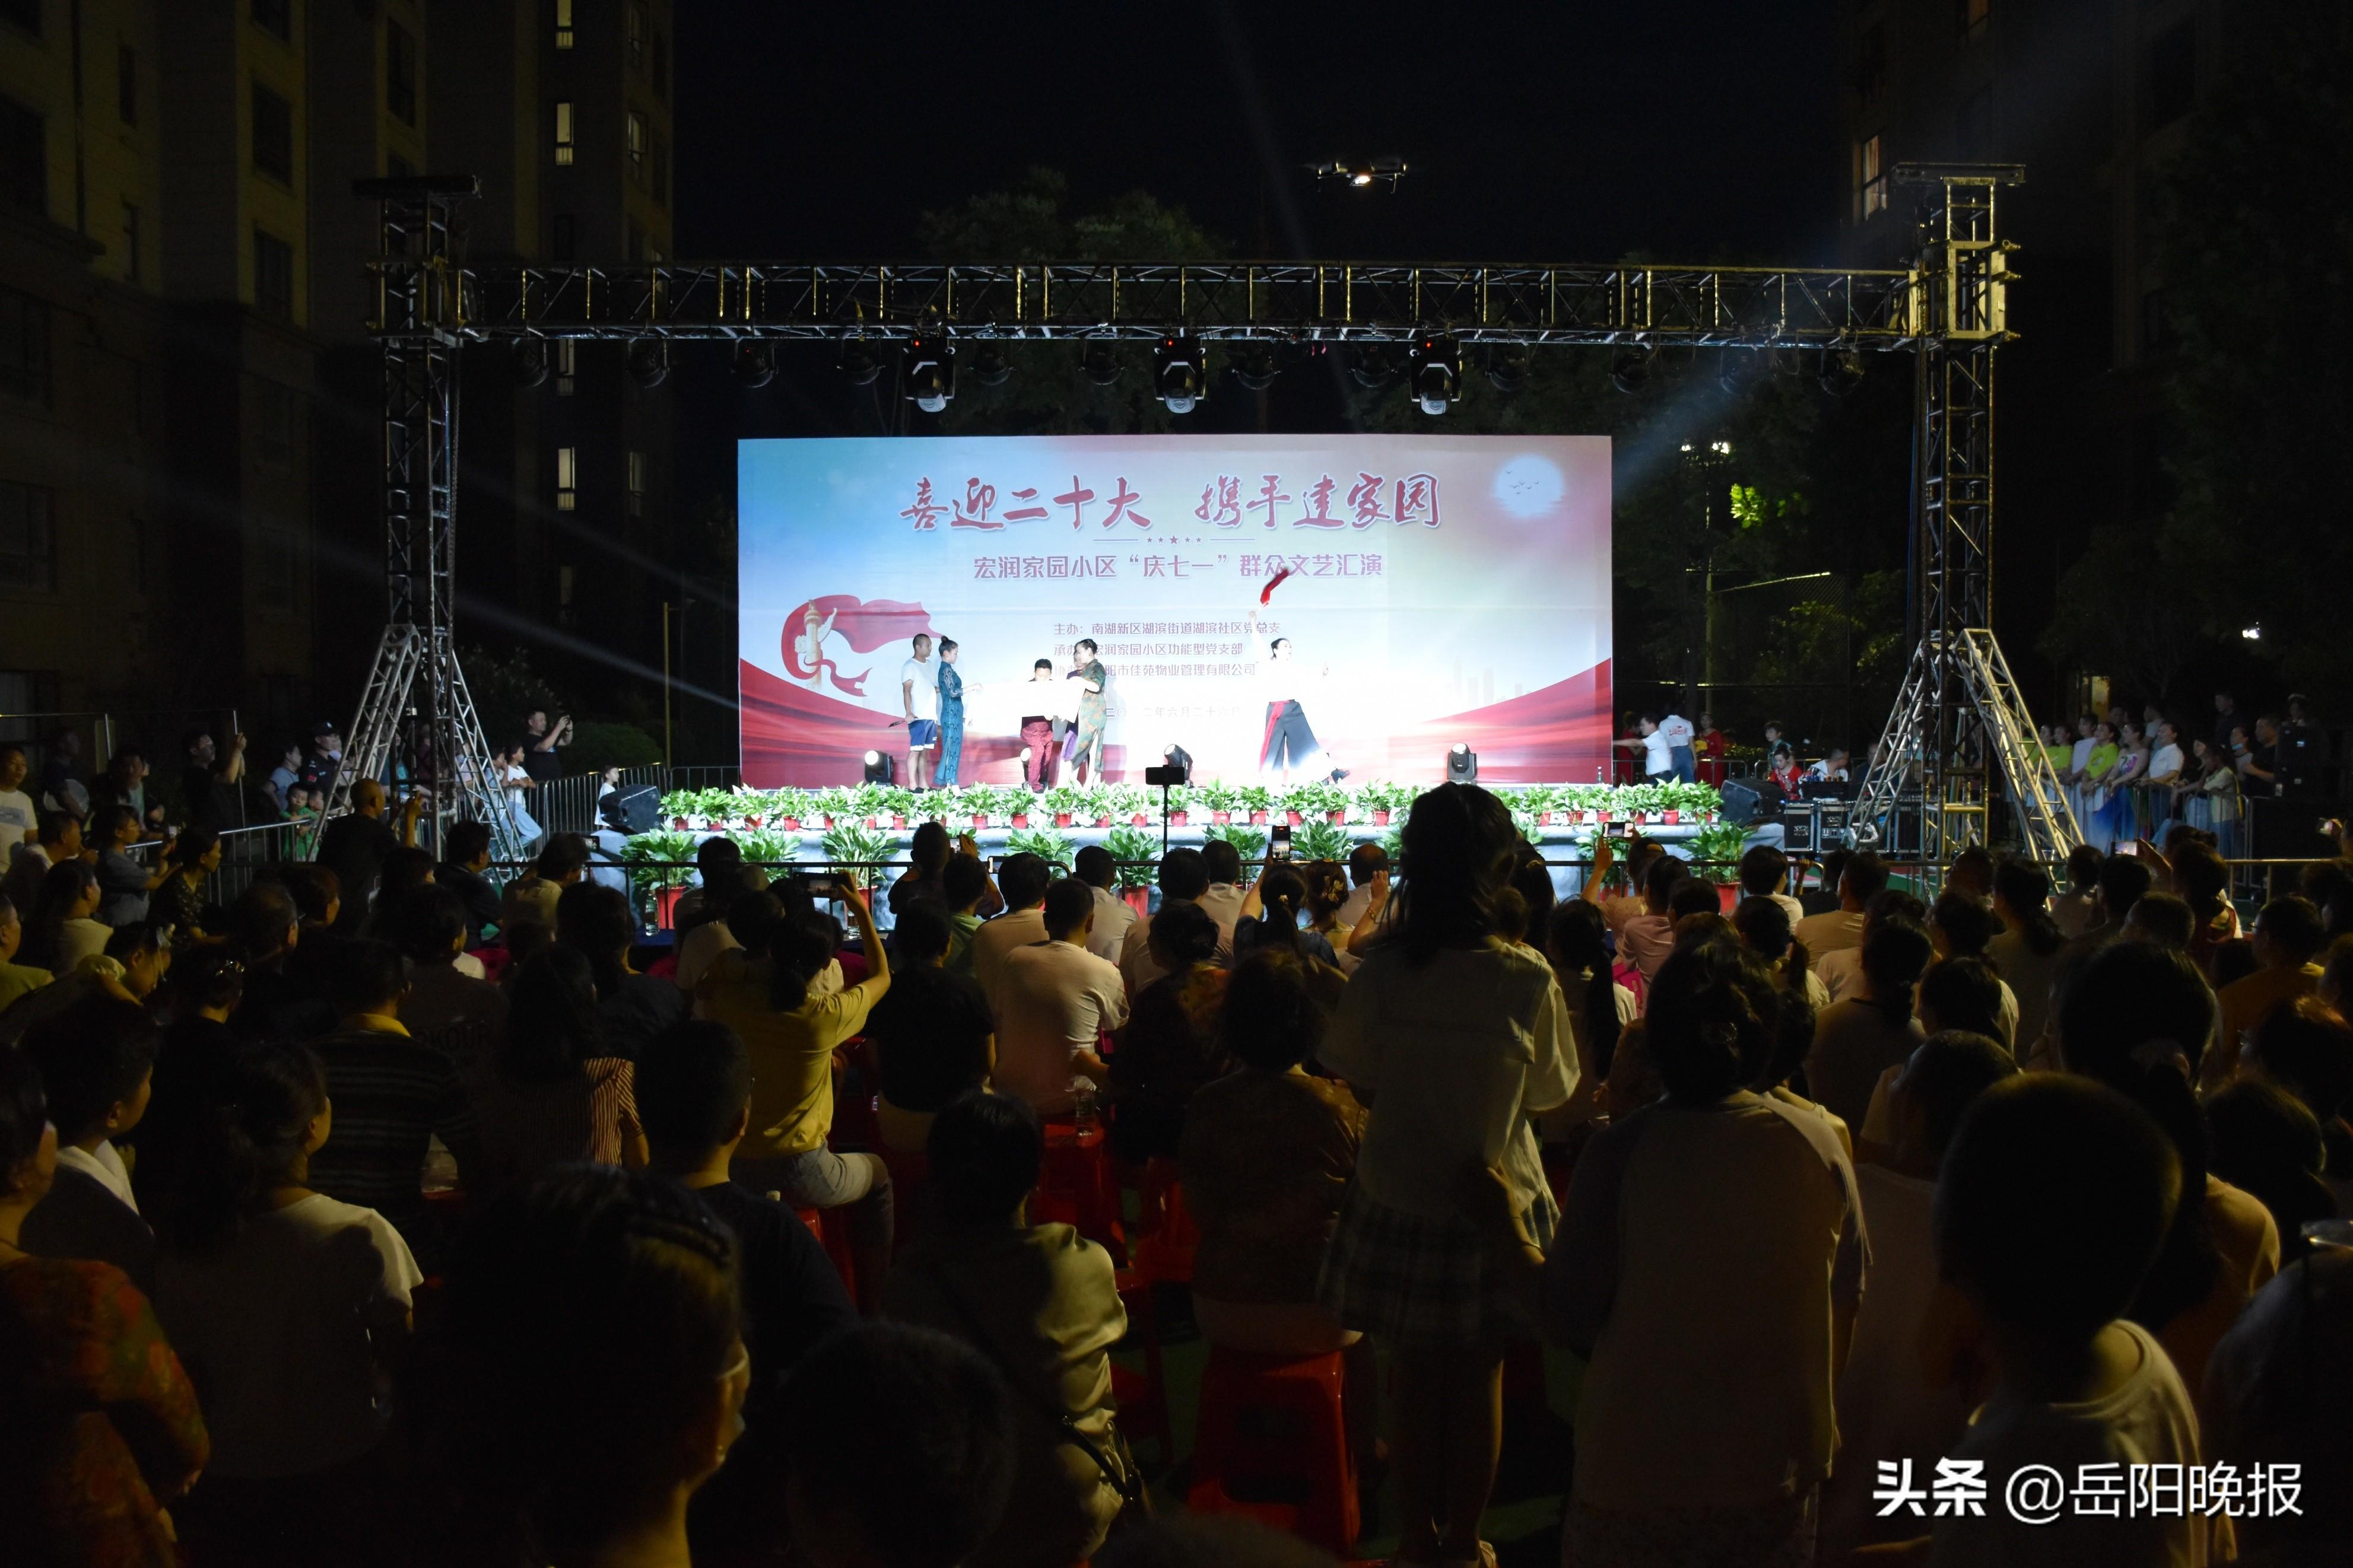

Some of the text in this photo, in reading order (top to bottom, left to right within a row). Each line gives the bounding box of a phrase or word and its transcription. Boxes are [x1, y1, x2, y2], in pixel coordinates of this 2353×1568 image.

[900, 472, 1439, 530] 喜迎二十大 携手建家园
